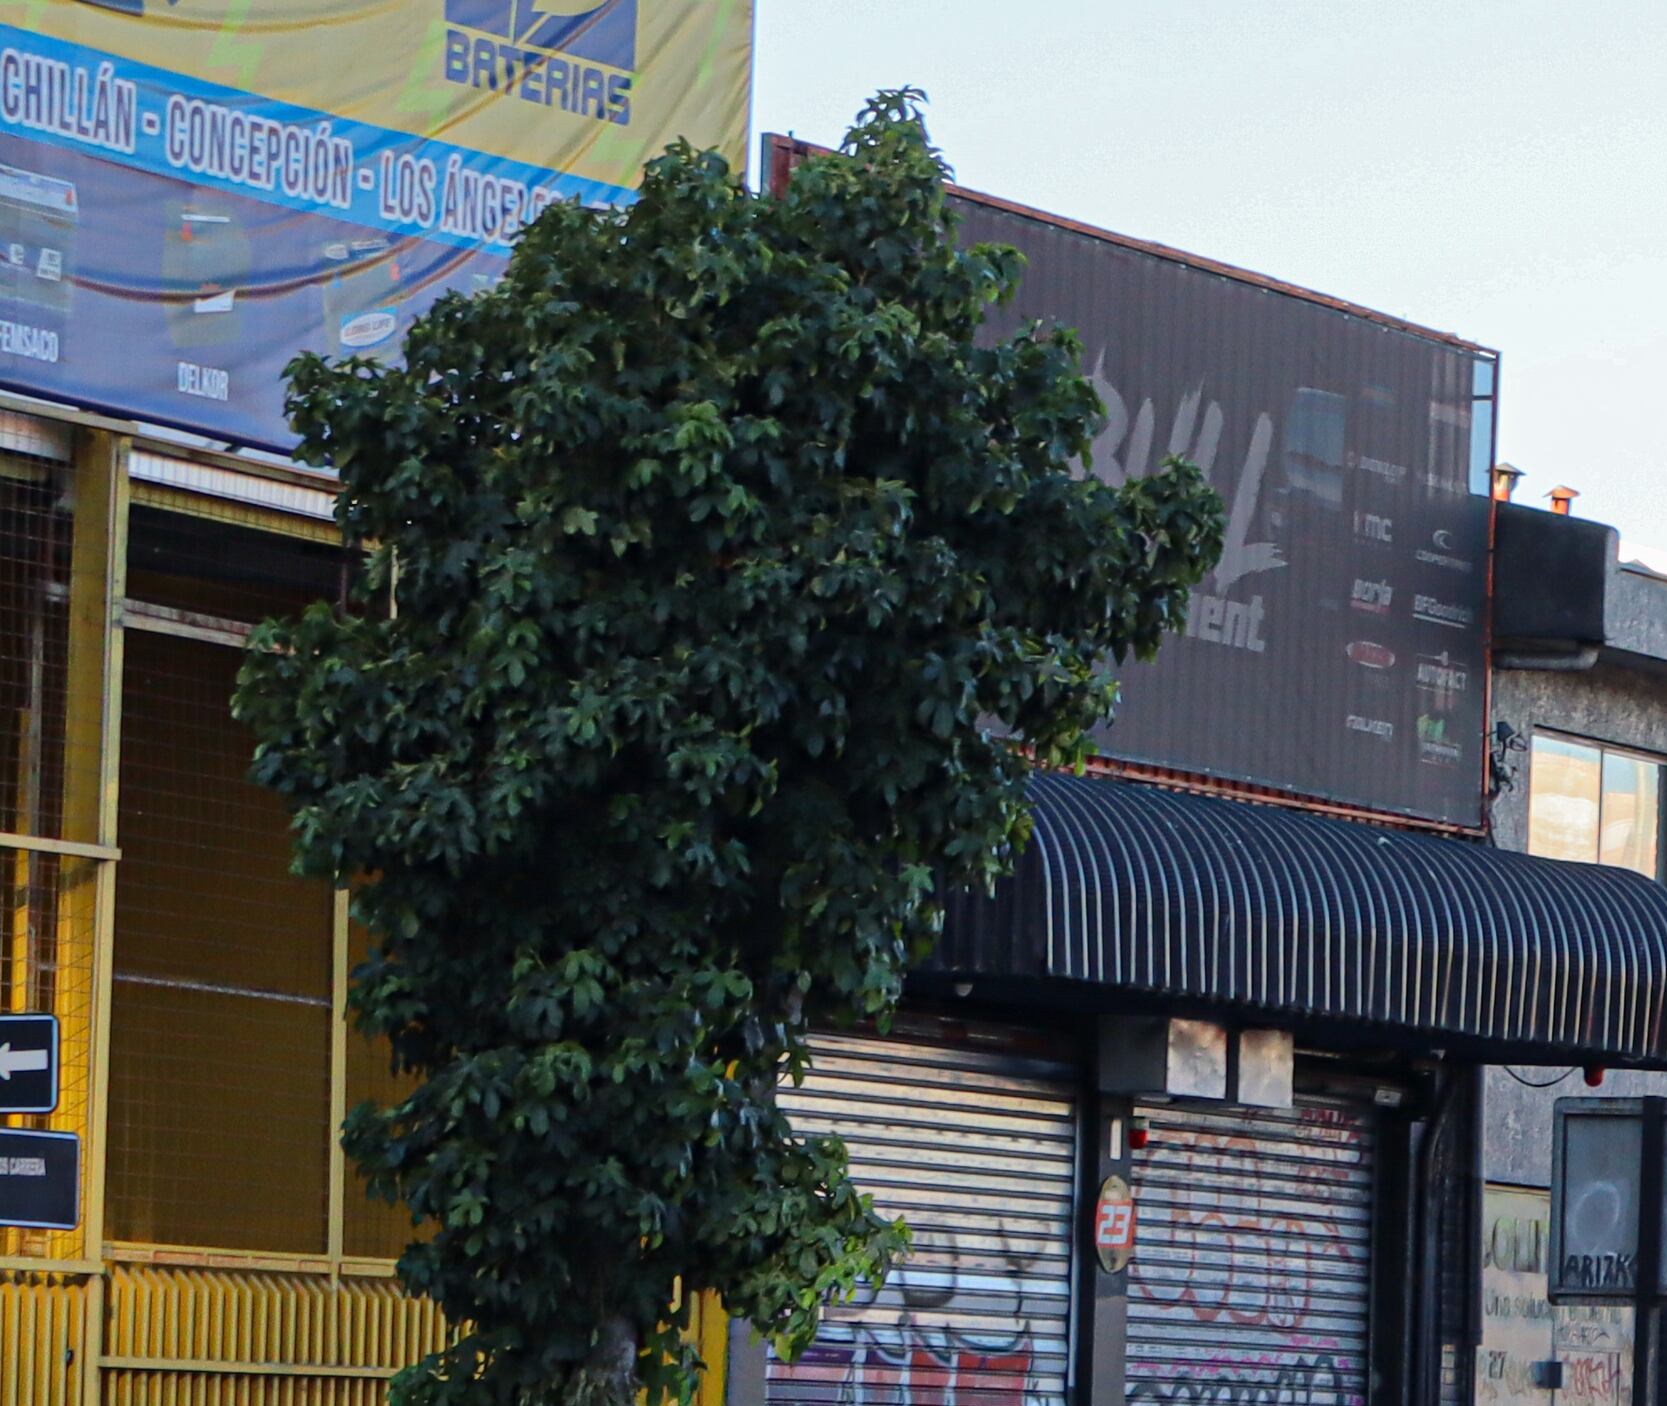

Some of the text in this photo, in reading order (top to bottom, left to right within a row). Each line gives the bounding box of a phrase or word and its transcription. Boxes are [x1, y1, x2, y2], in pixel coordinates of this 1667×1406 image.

[2, 50, 137, 155] CHILLÁN
[167, 94, 352, 209] CONCEPCIÓN
[380, 150, 437, 229] LOS
[444, 29, 632, 127] BATERIAS
